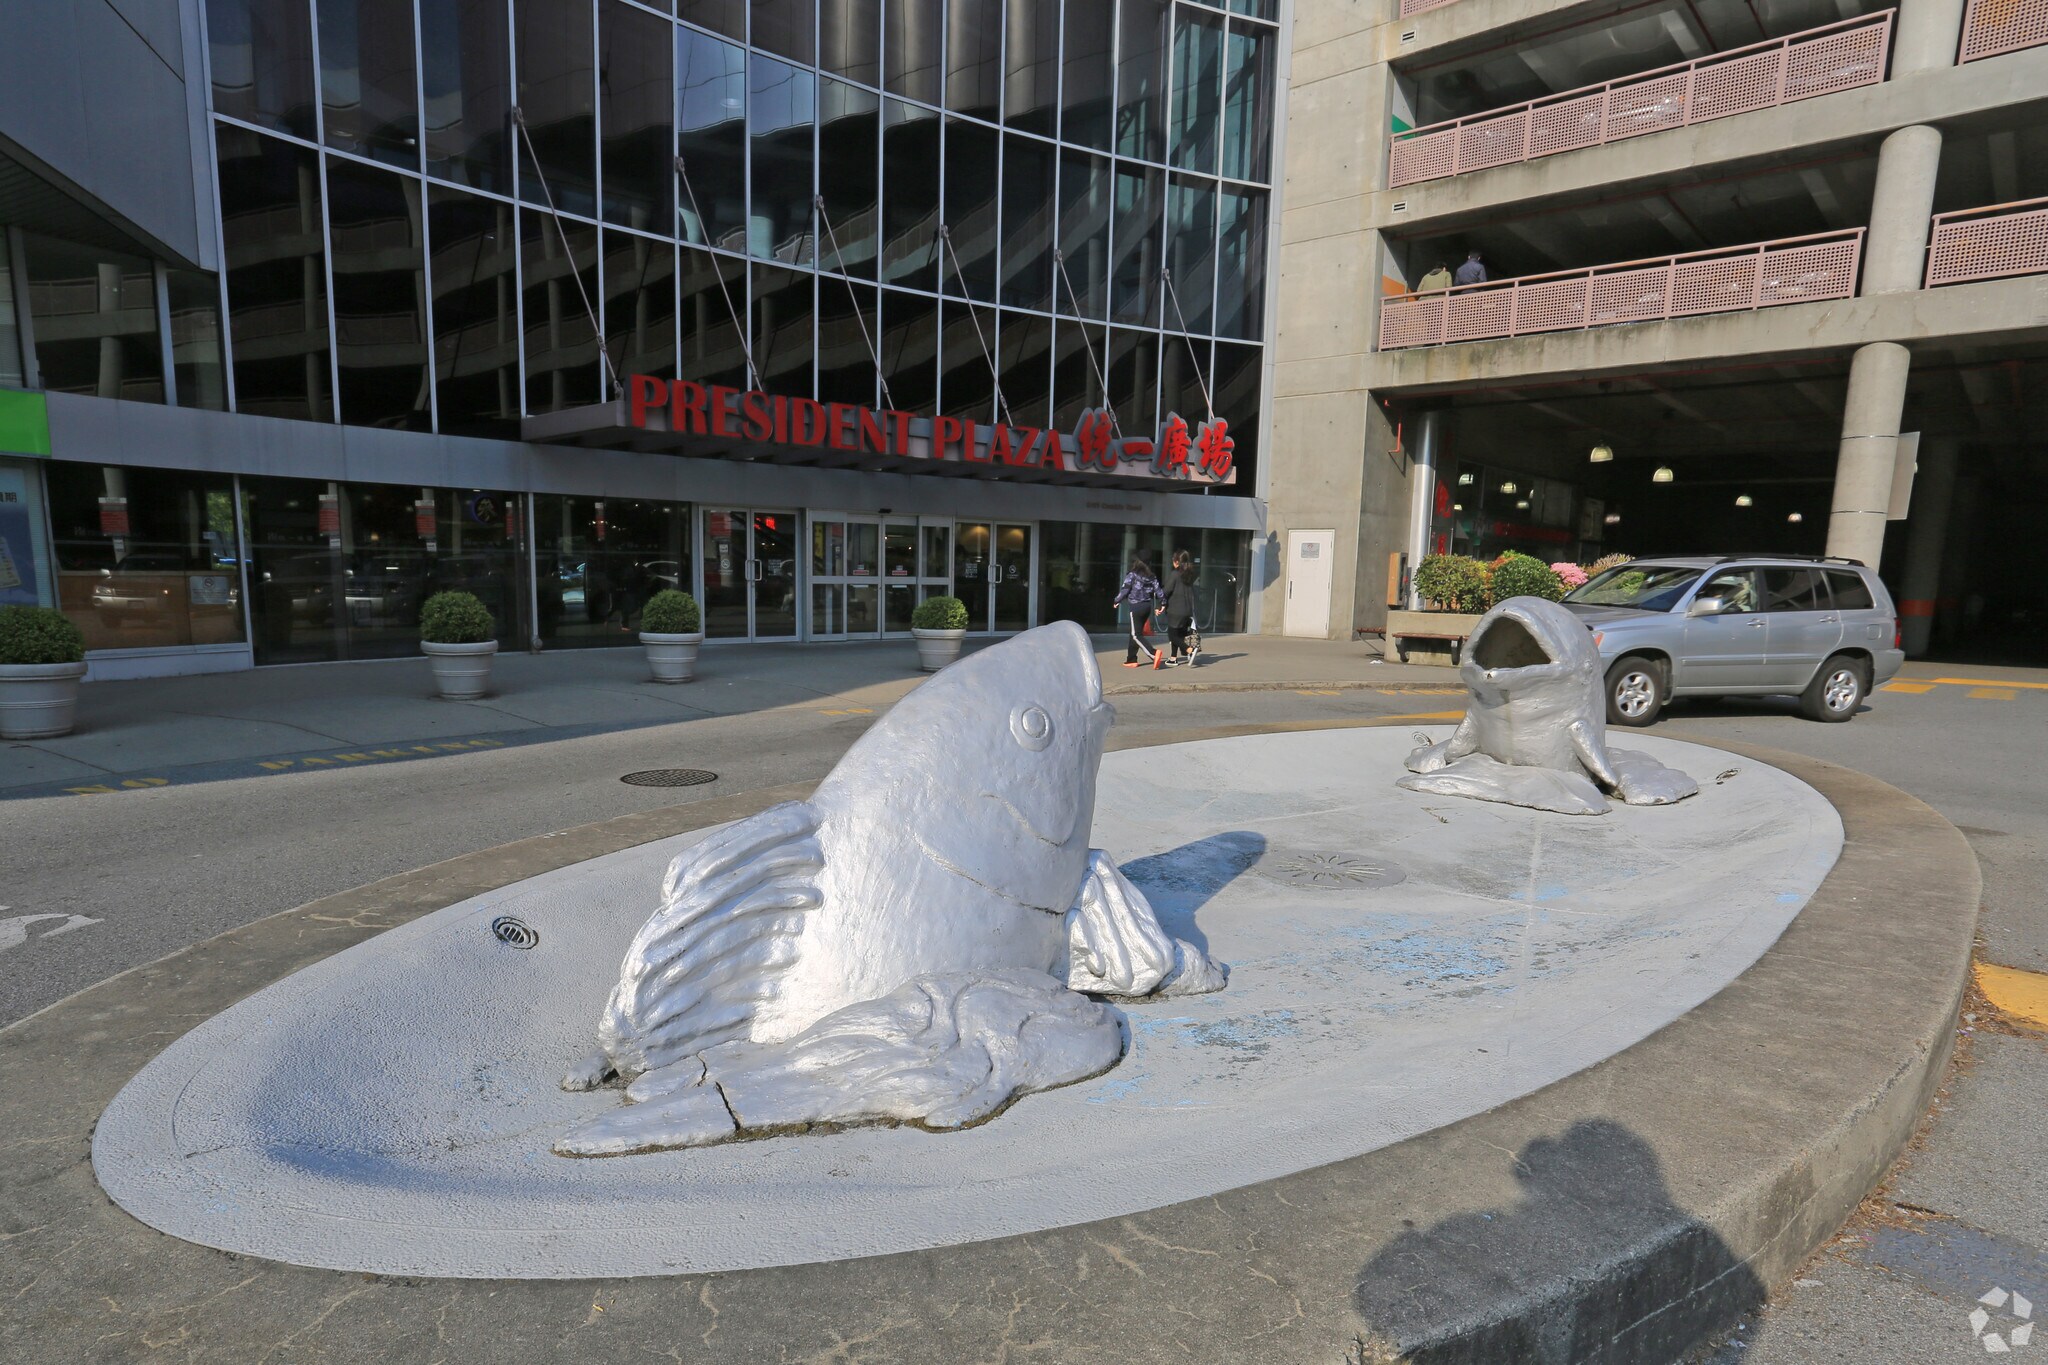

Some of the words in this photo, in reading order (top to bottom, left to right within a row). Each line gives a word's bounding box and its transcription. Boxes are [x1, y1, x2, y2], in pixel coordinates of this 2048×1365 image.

[630, 374, 918, 456] PRESIDENT
[934, 415, 1065, 471] PLAZA
[63, 777, 169, 797] NO
[258, 739, 504, 770] PARKING
